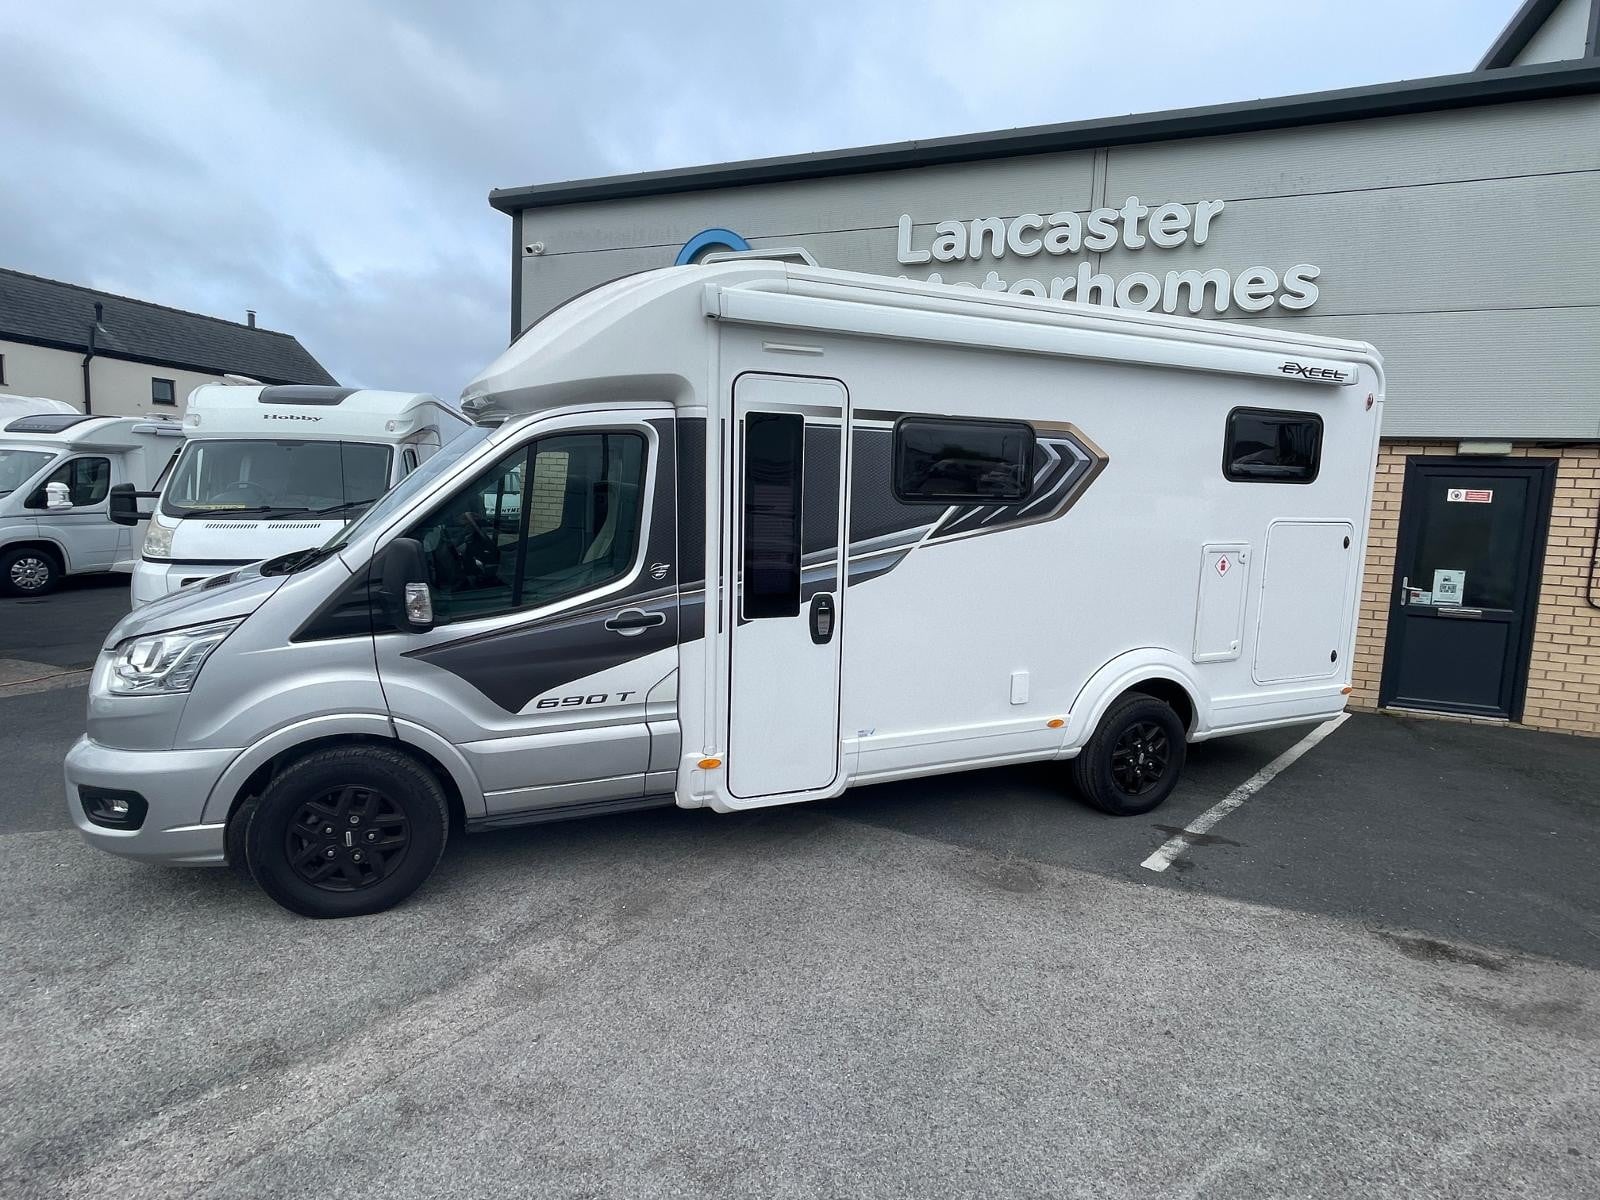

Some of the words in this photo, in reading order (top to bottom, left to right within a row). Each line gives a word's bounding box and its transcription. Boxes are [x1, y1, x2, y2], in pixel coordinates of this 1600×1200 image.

[897, 196, 1225, 264] Lancaster
[898, 262, 1322, 313] rhomes
[1279, 361, 1348, 382] EXCEL
[263, 414, 324, 422] Hobby
[536, 693, 609, 709] 690
[616, 691, 636, 702] T
